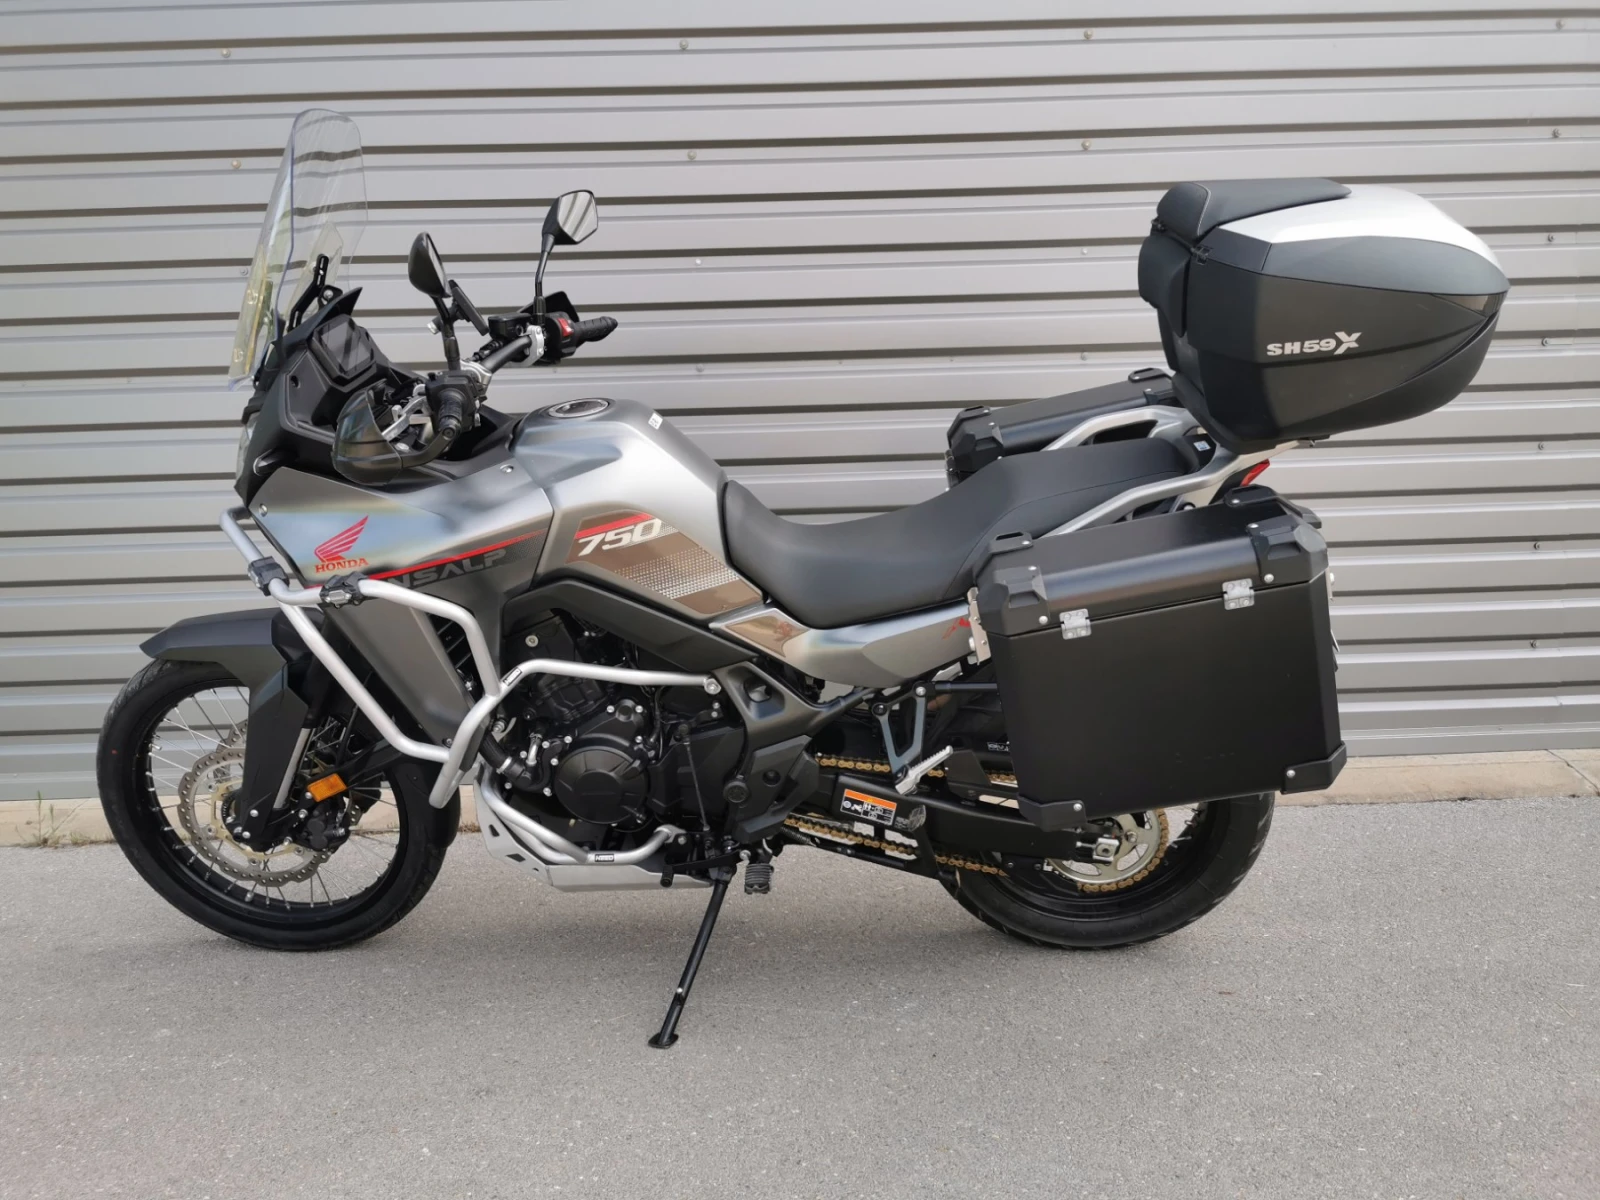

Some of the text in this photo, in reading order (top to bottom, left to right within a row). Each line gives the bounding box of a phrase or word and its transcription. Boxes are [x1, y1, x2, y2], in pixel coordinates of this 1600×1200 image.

[1266, 331, 1362, 356] SH59X
[578, 518, 662, 557] 750
[315, 557, 369, 574] HONDA
